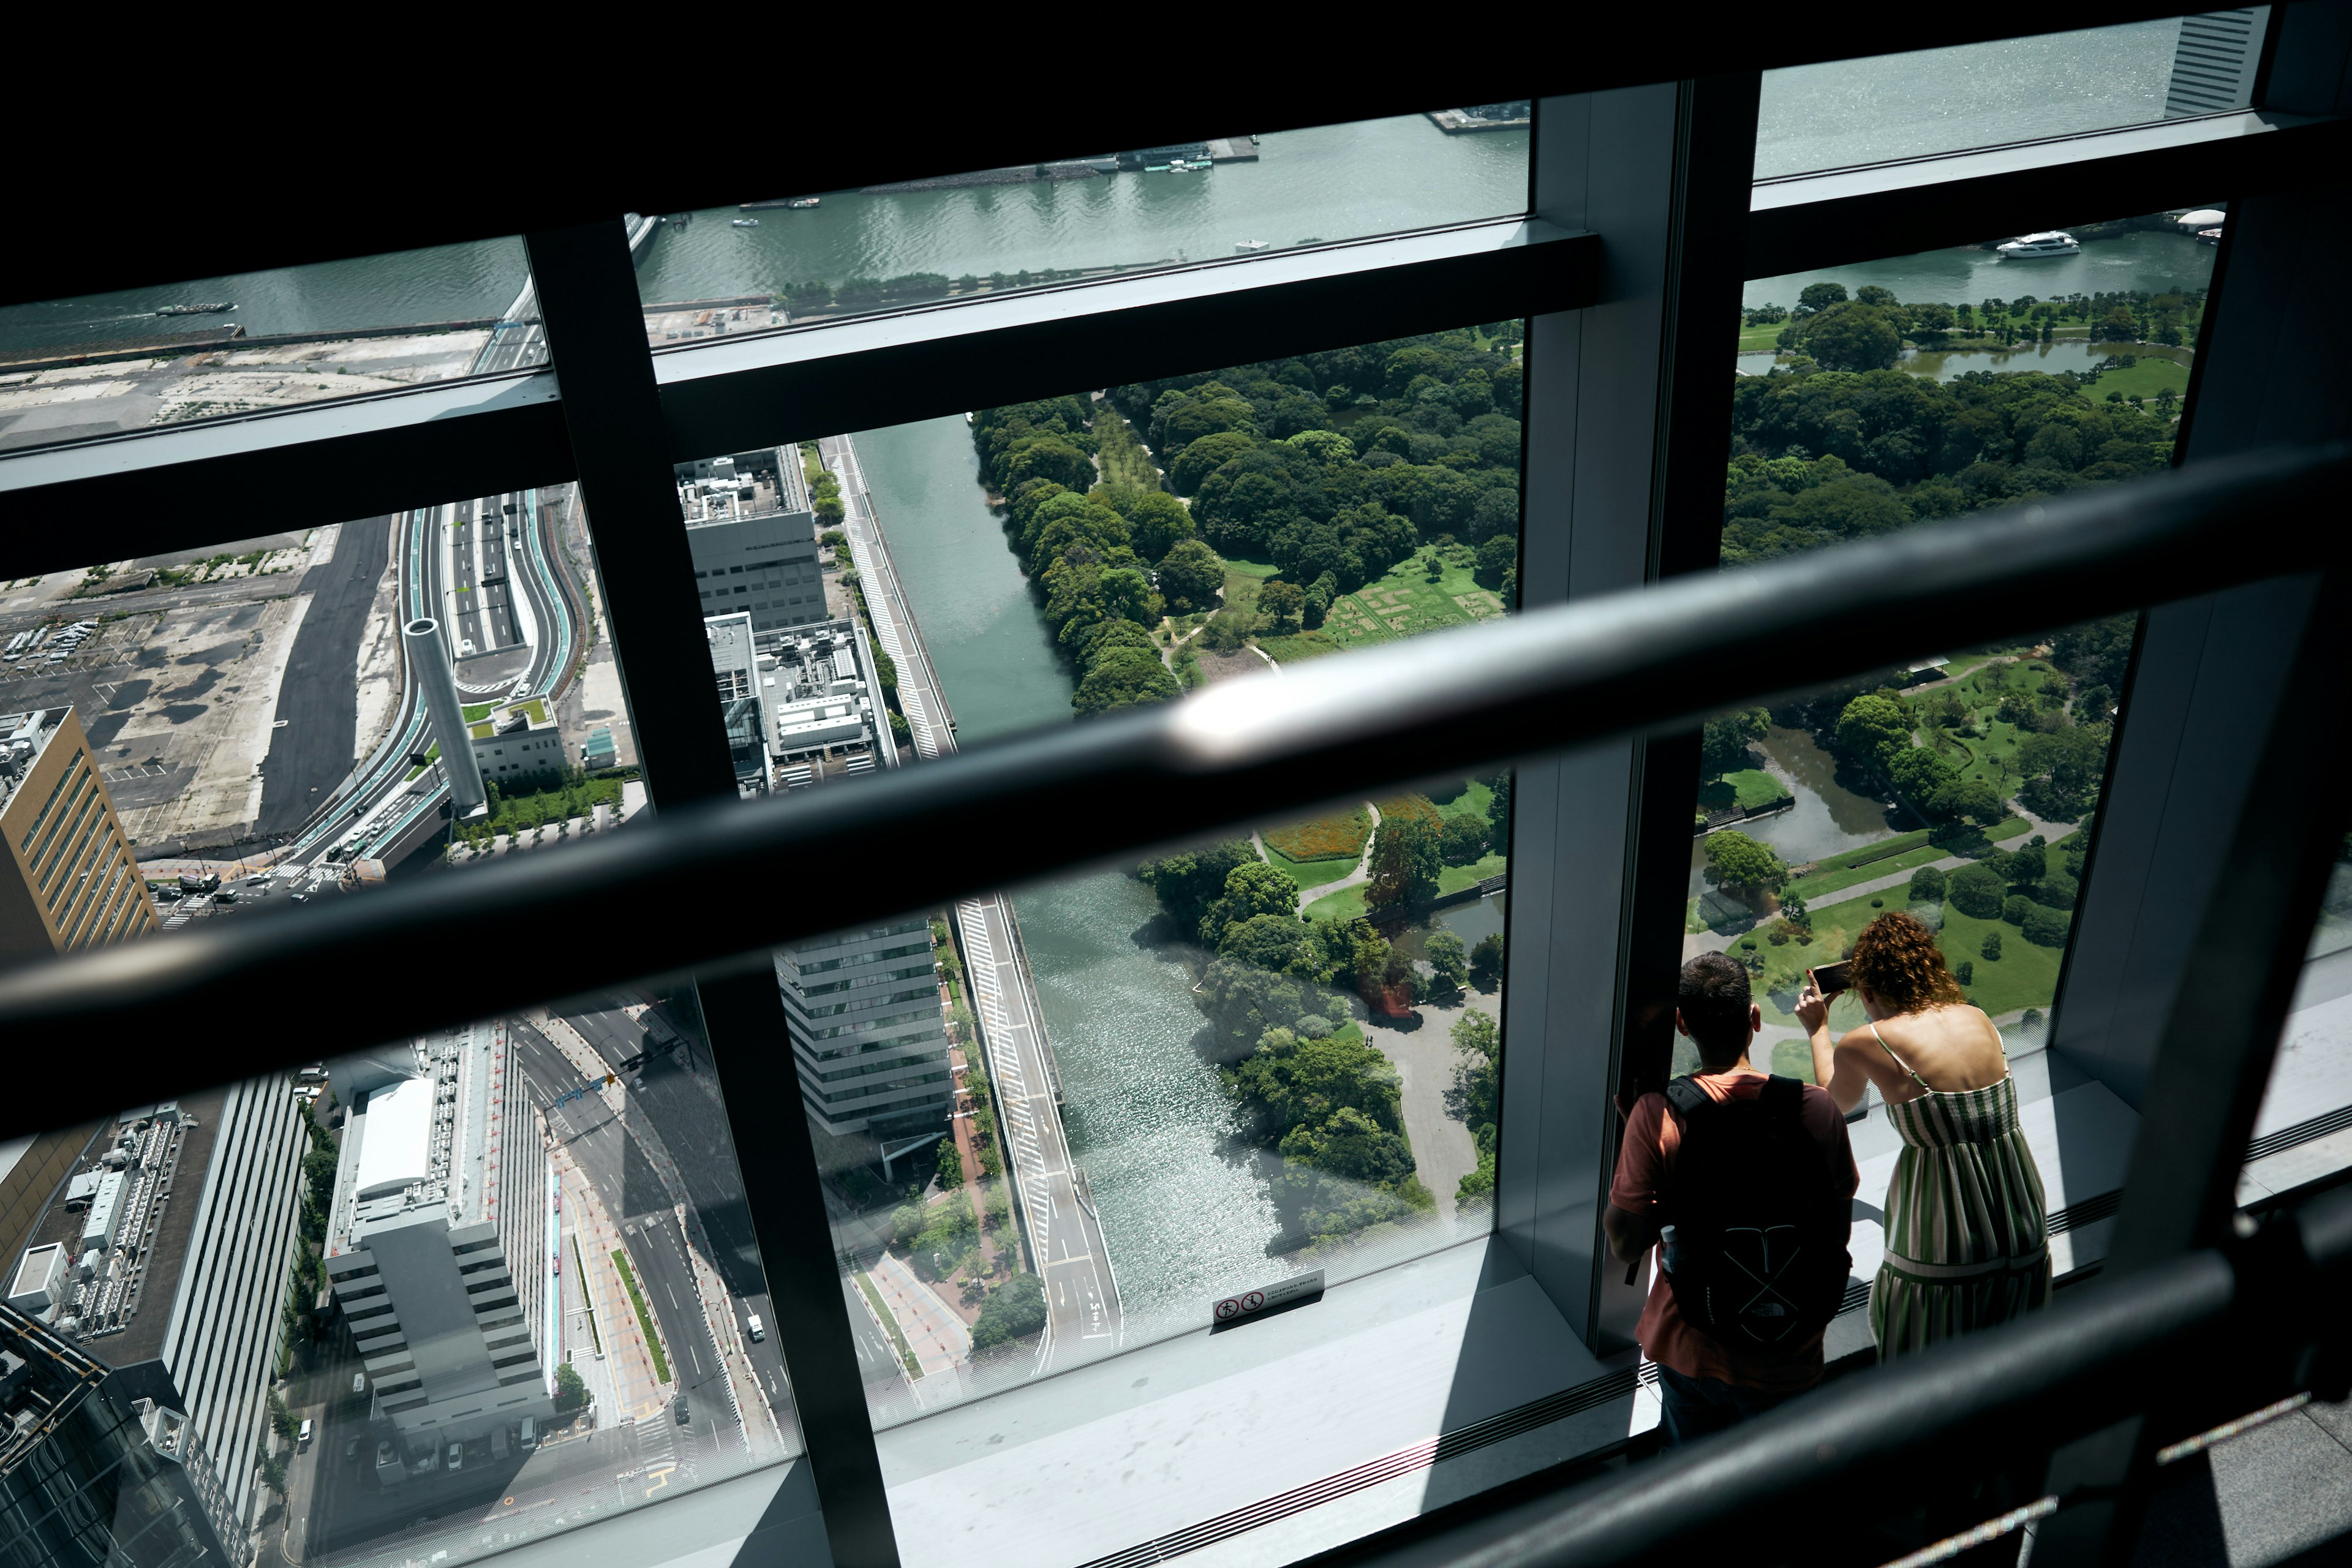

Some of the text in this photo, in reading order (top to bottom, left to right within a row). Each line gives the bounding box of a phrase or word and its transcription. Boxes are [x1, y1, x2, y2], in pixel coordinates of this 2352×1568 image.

[1267, 1278, 1317, 1295] ここに上がったり、すわったり
